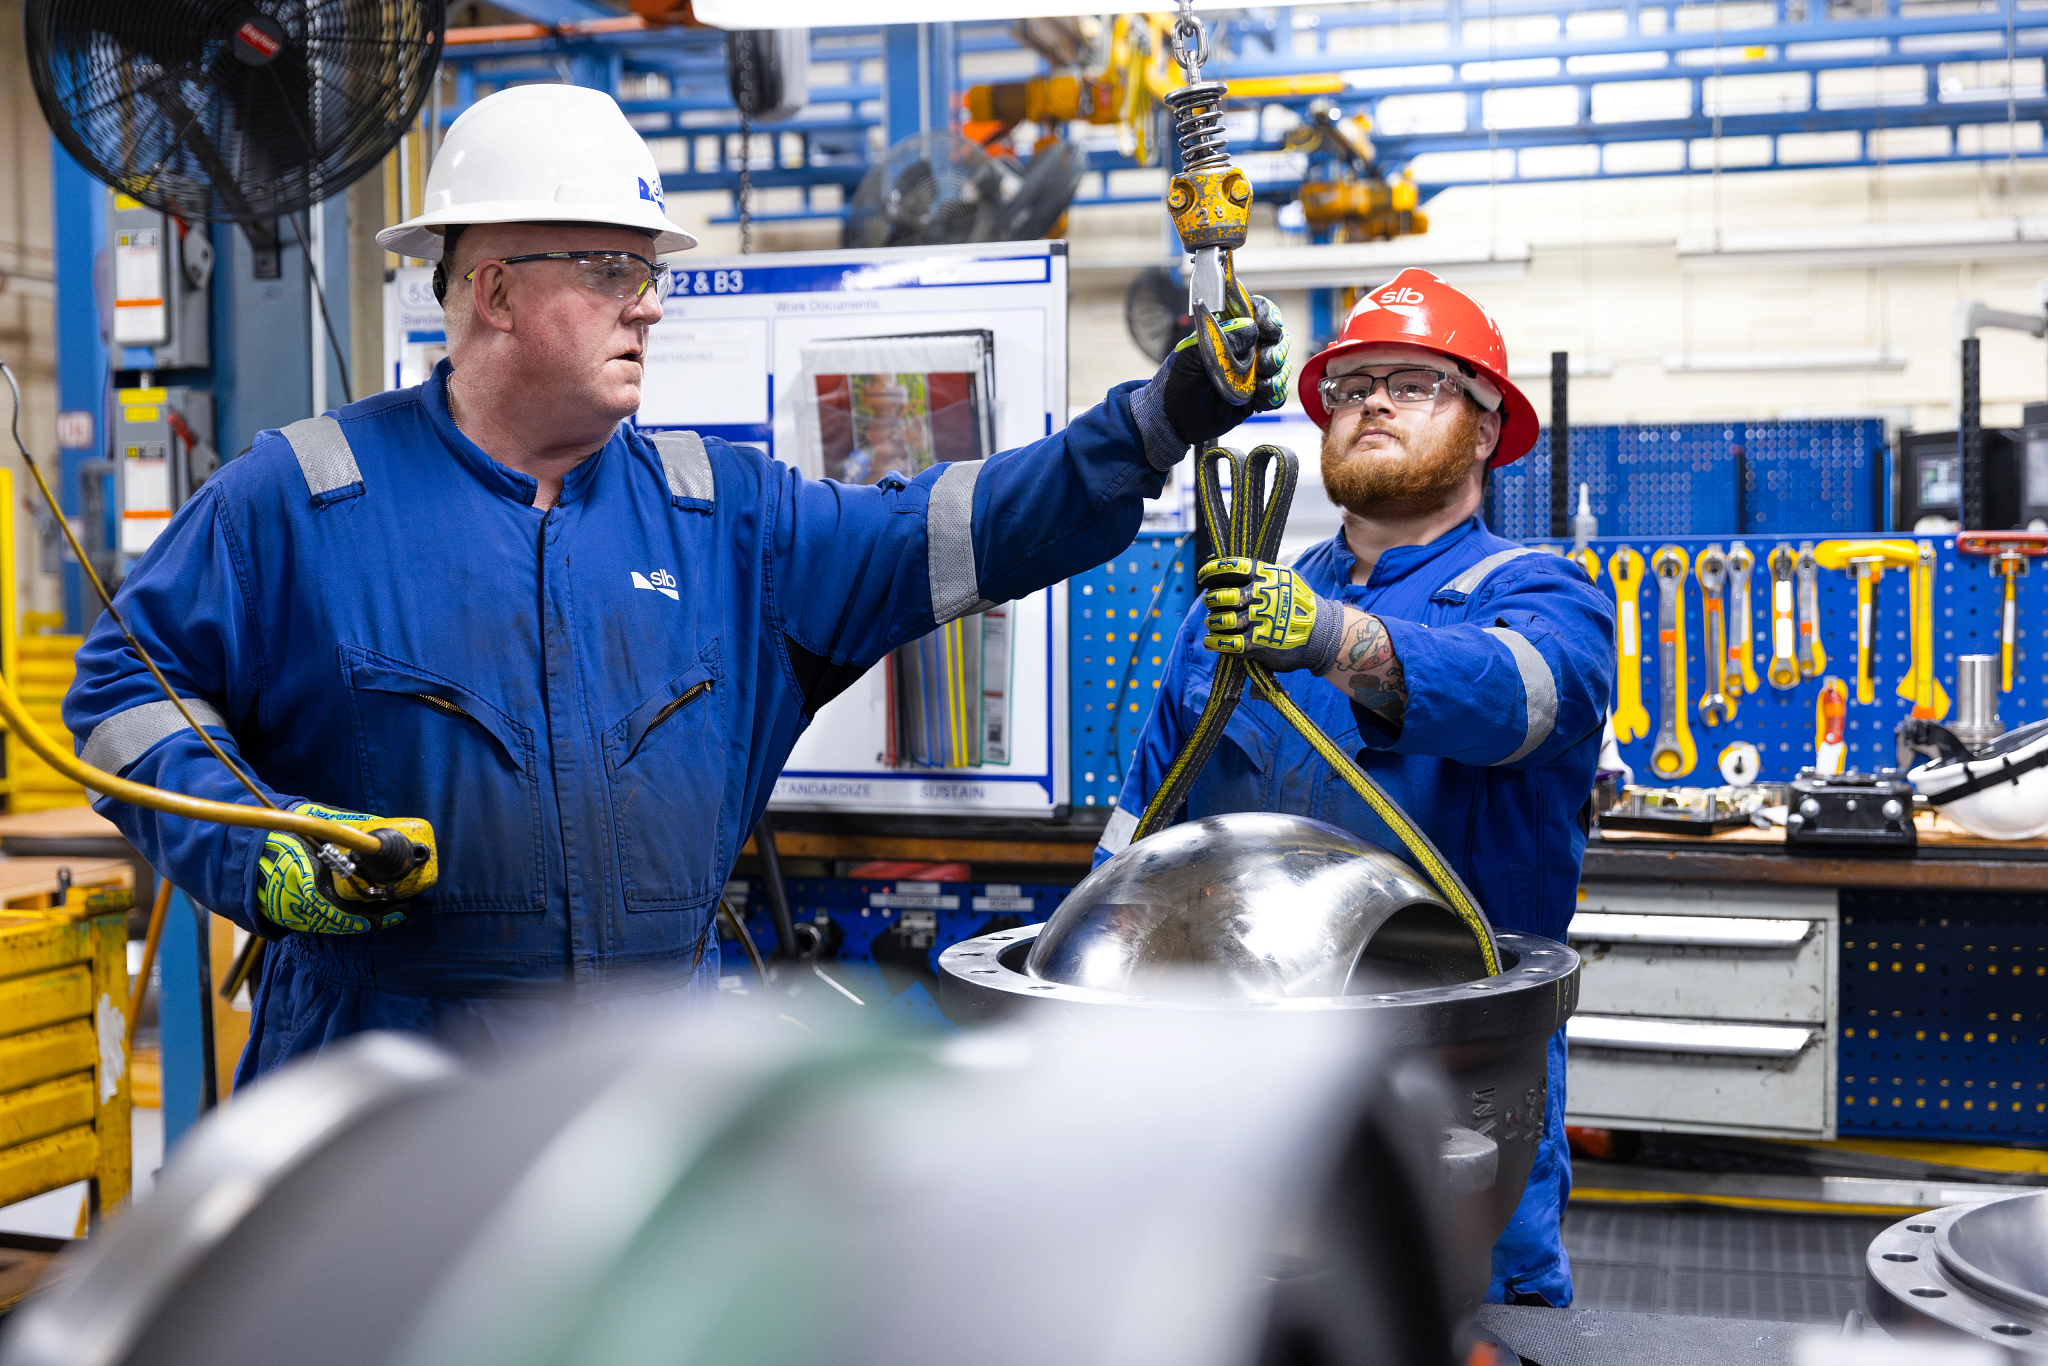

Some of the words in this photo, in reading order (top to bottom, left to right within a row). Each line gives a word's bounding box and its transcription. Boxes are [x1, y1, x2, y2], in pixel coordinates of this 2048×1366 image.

[1196, 207, 1210, 226] 2
[1214, 204, 1223, 218] t
[693, 271, 711, 295] &
[714, 270, 744, 294] B3
[1379, 287, 1424, 304] slb
[775, 299, 806, 313] Work
[809, 298, 880, 312] Documents
[650, 569, 676, 588] slb
[920, 785, 985, 799] SUSTAIN
[306, 807, 371, 821] HexArmor
